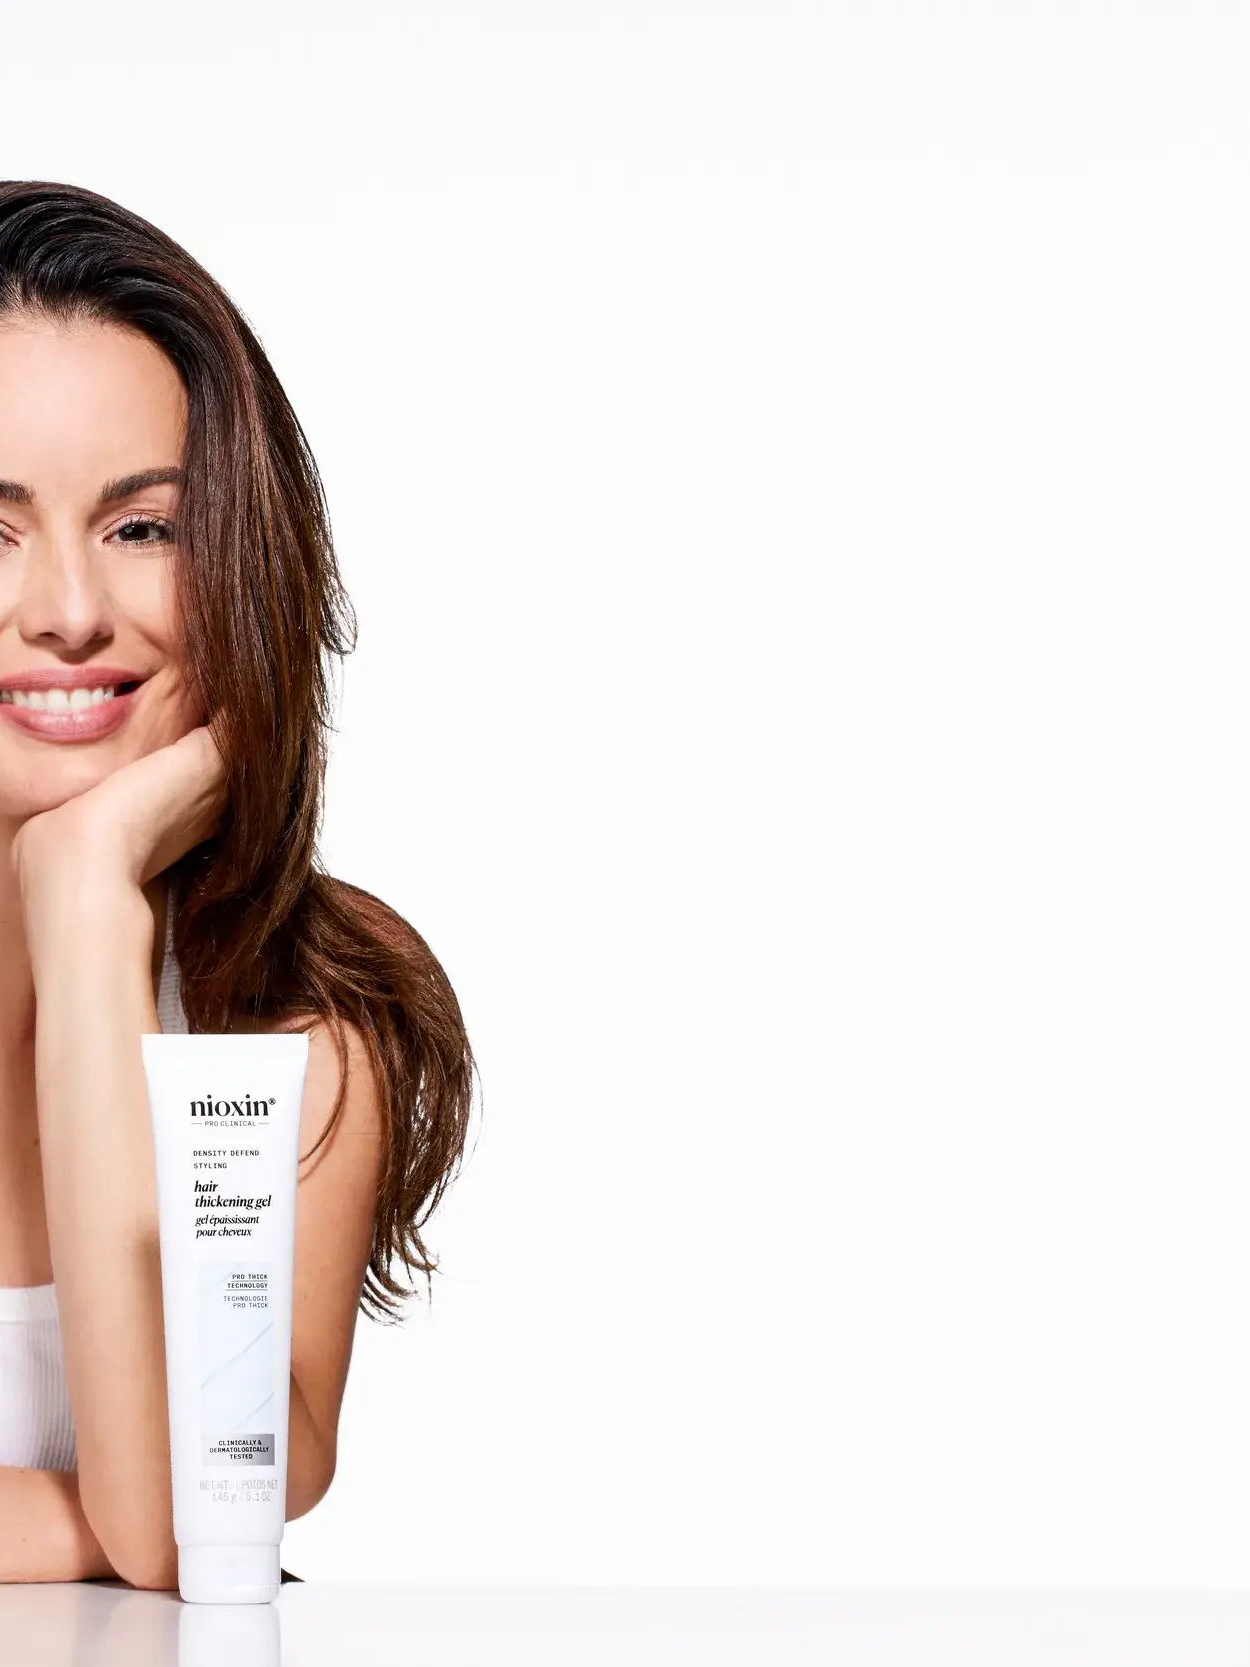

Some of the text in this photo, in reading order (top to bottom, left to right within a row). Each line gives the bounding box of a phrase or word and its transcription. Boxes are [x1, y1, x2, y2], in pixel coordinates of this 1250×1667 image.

[194, 1180, 218, 1192] hair
[194, 1195, 272, 1210] thickening gel
[195, 1214, 260, 1227] gel épaississant
[196, 1227, 252, 1240] pour cheveux
[200, 1480, 214, 1490] NET
[242, 1479, 266, 1490] POIDS
[267, 1479, 278, 1490] NET
